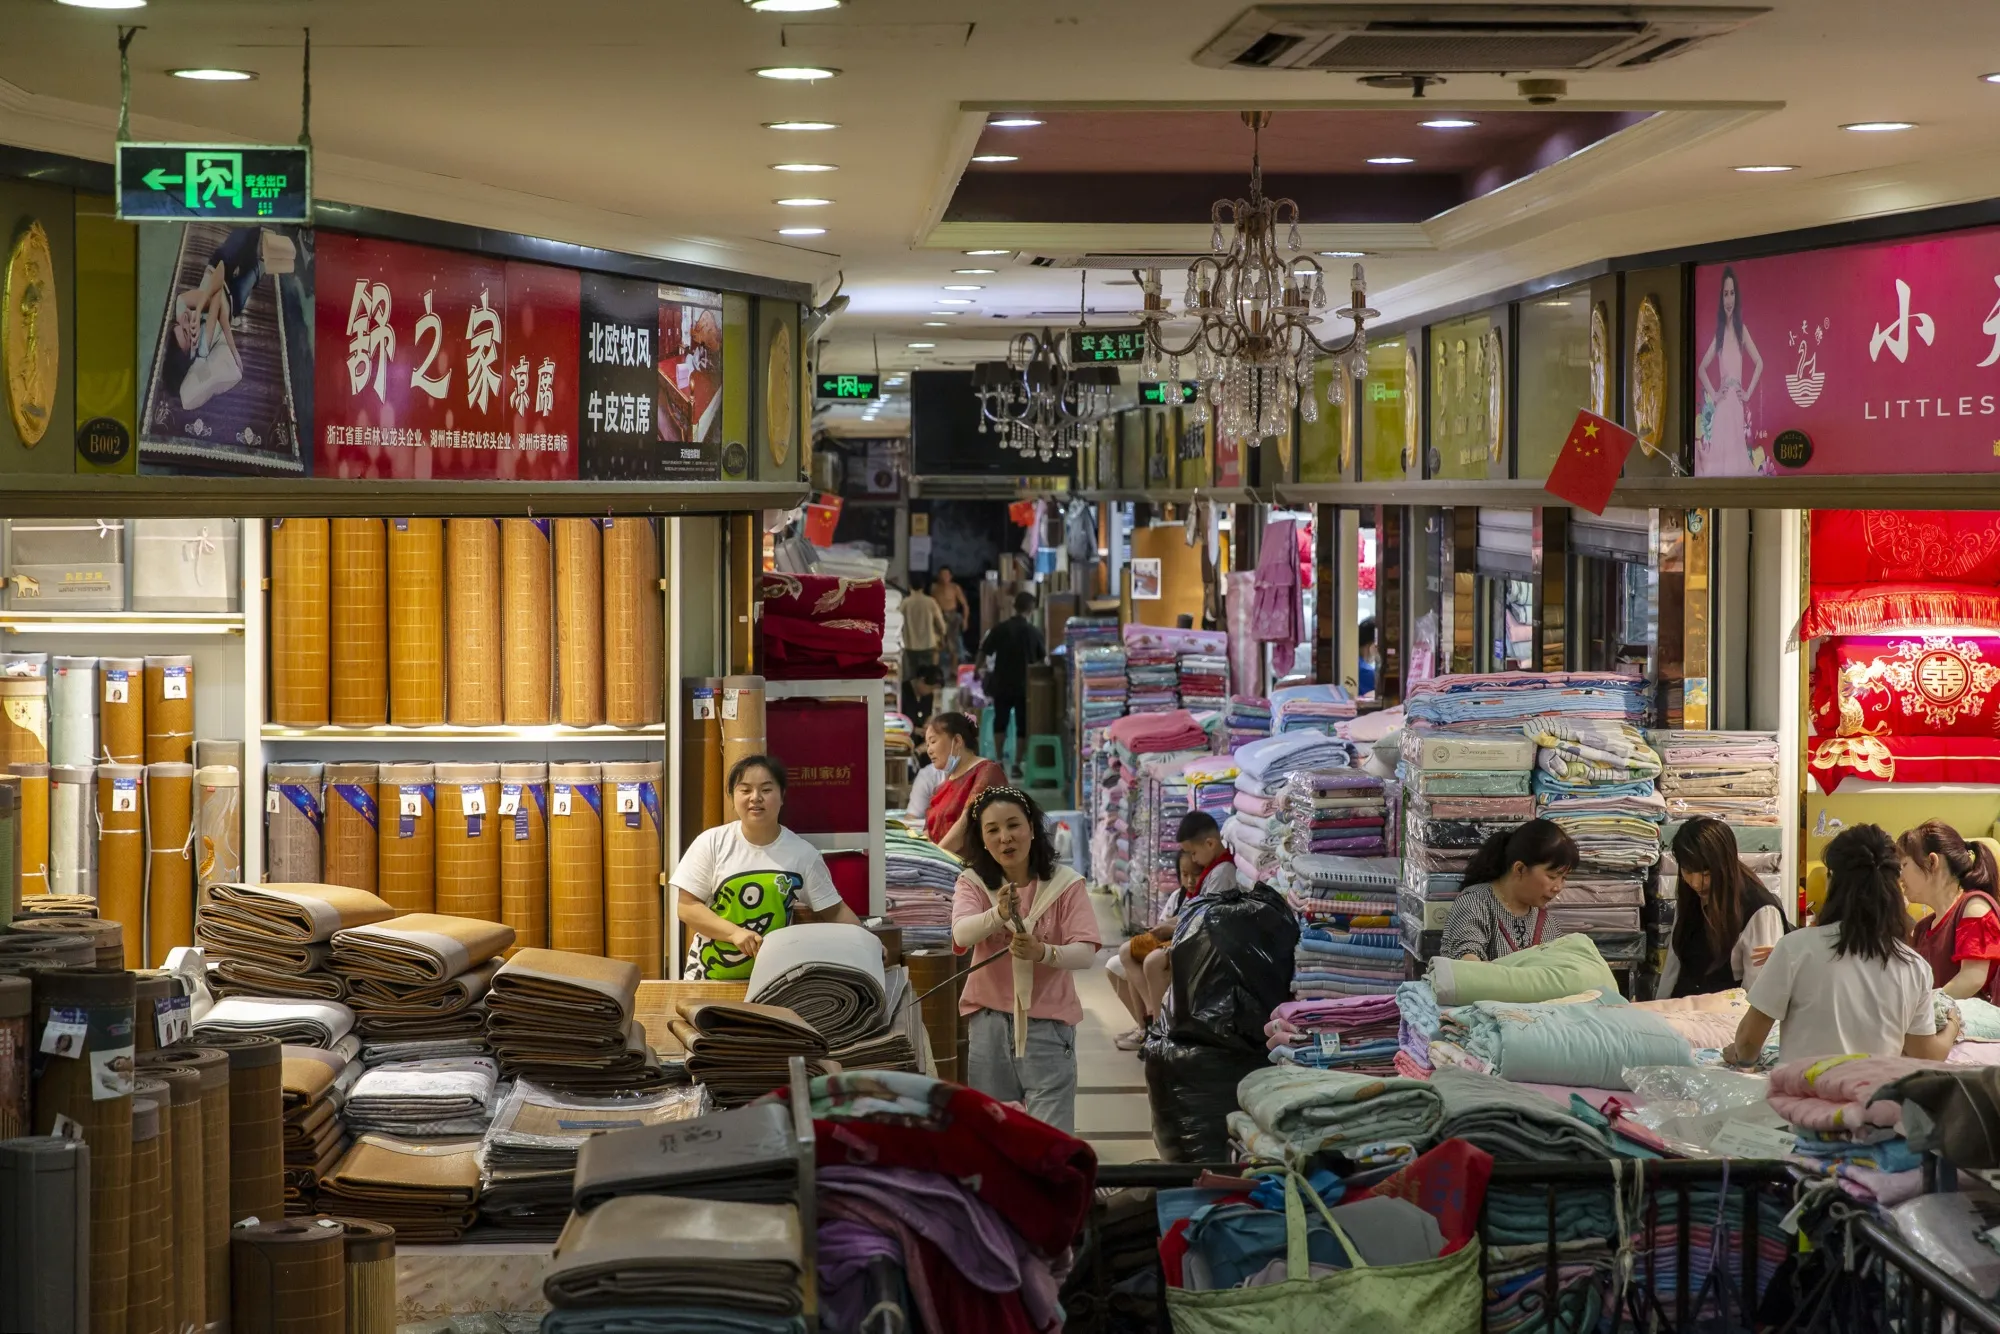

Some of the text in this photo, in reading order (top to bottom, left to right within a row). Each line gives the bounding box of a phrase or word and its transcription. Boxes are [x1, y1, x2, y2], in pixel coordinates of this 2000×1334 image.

[245, 174, 287, 188] 安全出口
[251, 188, 280, 198] EXIT
[346, 278, 555, 417] 舒之家 凉席
[588, 322, 651, 369] 北欧牧风
[1081, 333, 1145, 351] 安全出口
[1094, 349, 1136, 360] EXIT
[588, 390, 651, 435] 牛皮凉席
[1864, 395, 1996, 420] LITTLES
[90, 434, 120, 455] B002
[1780, 443, 1804, 460] B037
[786, 766, 851, 780] 三利家纺
